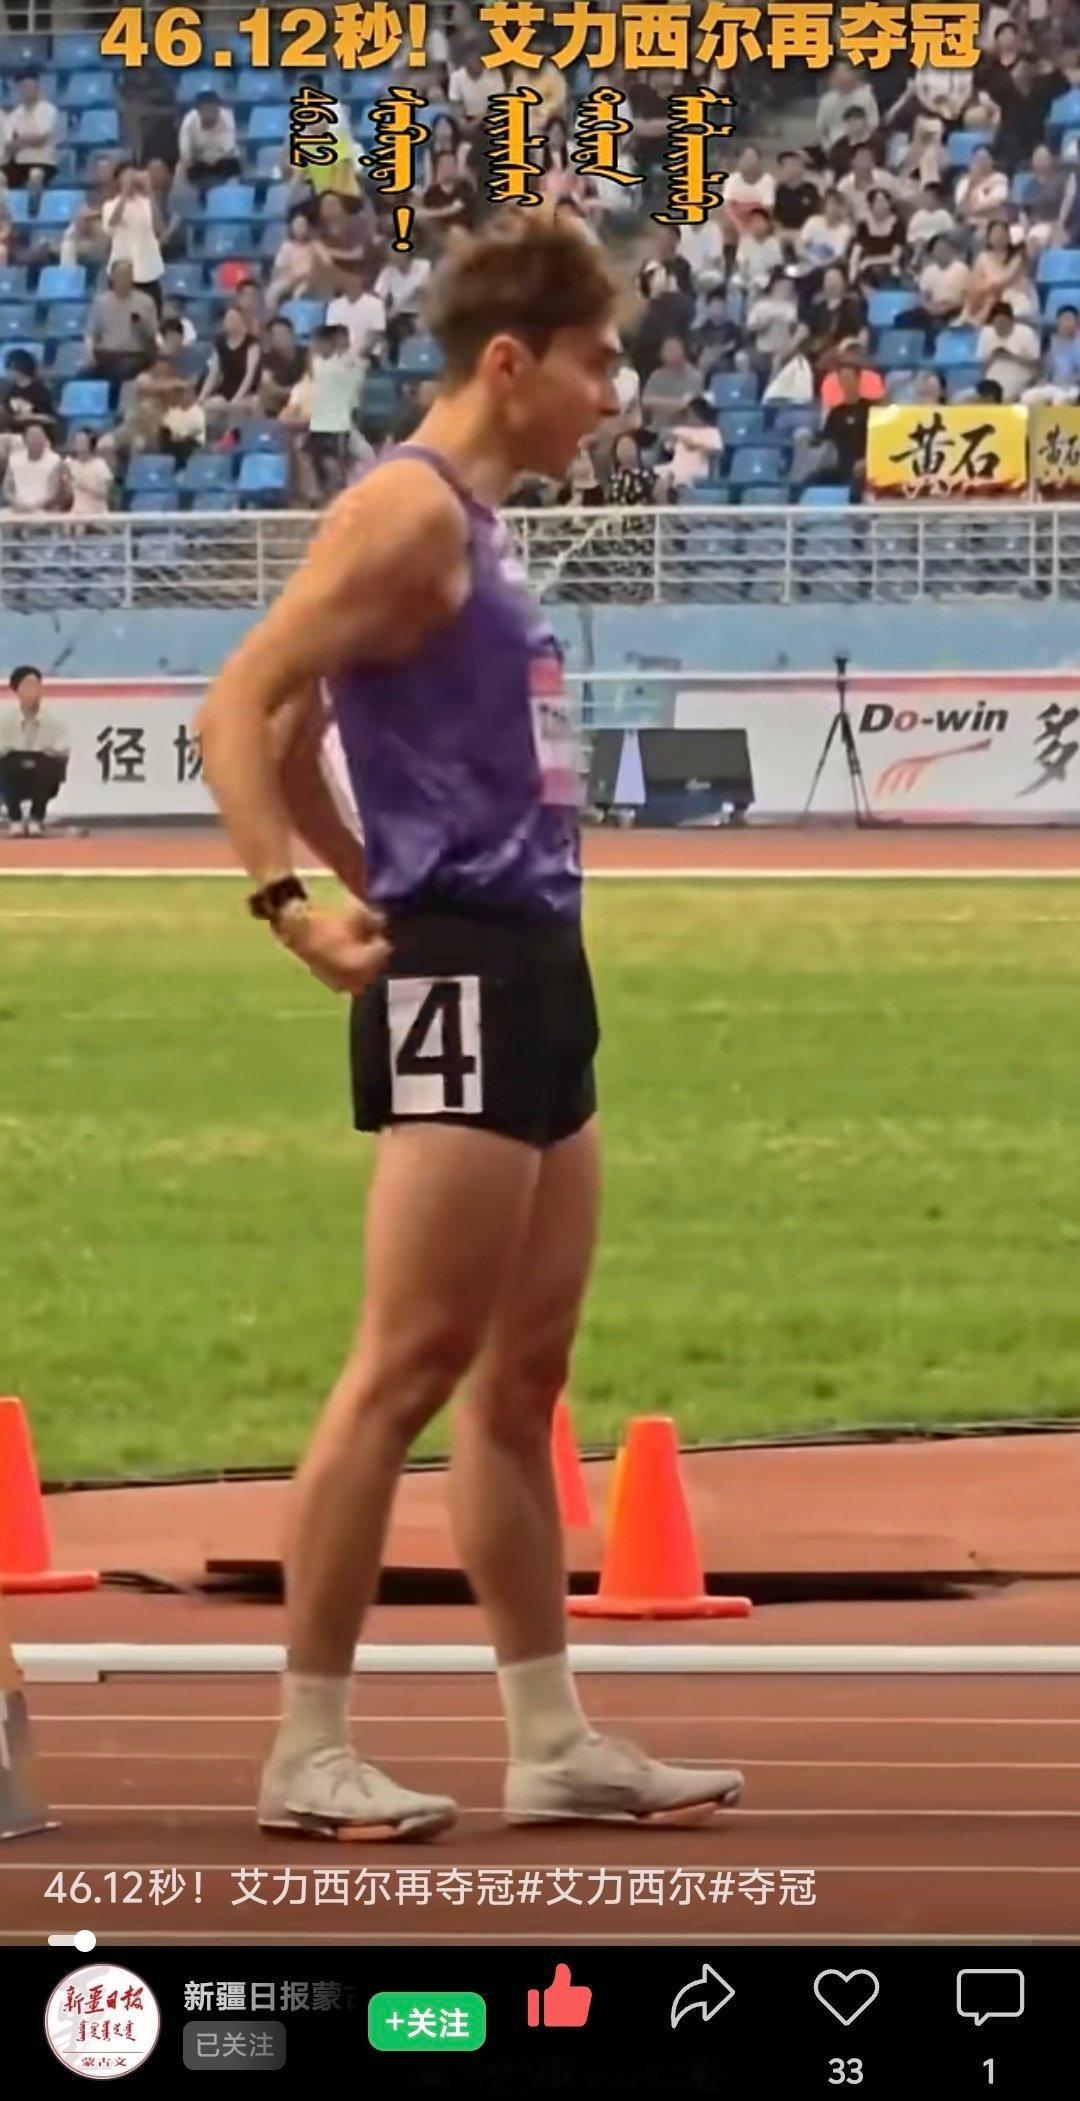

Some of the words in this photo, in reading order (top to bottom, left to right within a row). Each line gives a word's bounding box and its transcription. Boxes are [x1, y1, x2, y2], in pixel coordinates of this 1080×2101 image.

[889, 412, 1001, 480] 黄石
[859, 700, 1009, 733] Do-win
[396, 981, 476, 1108] 4
